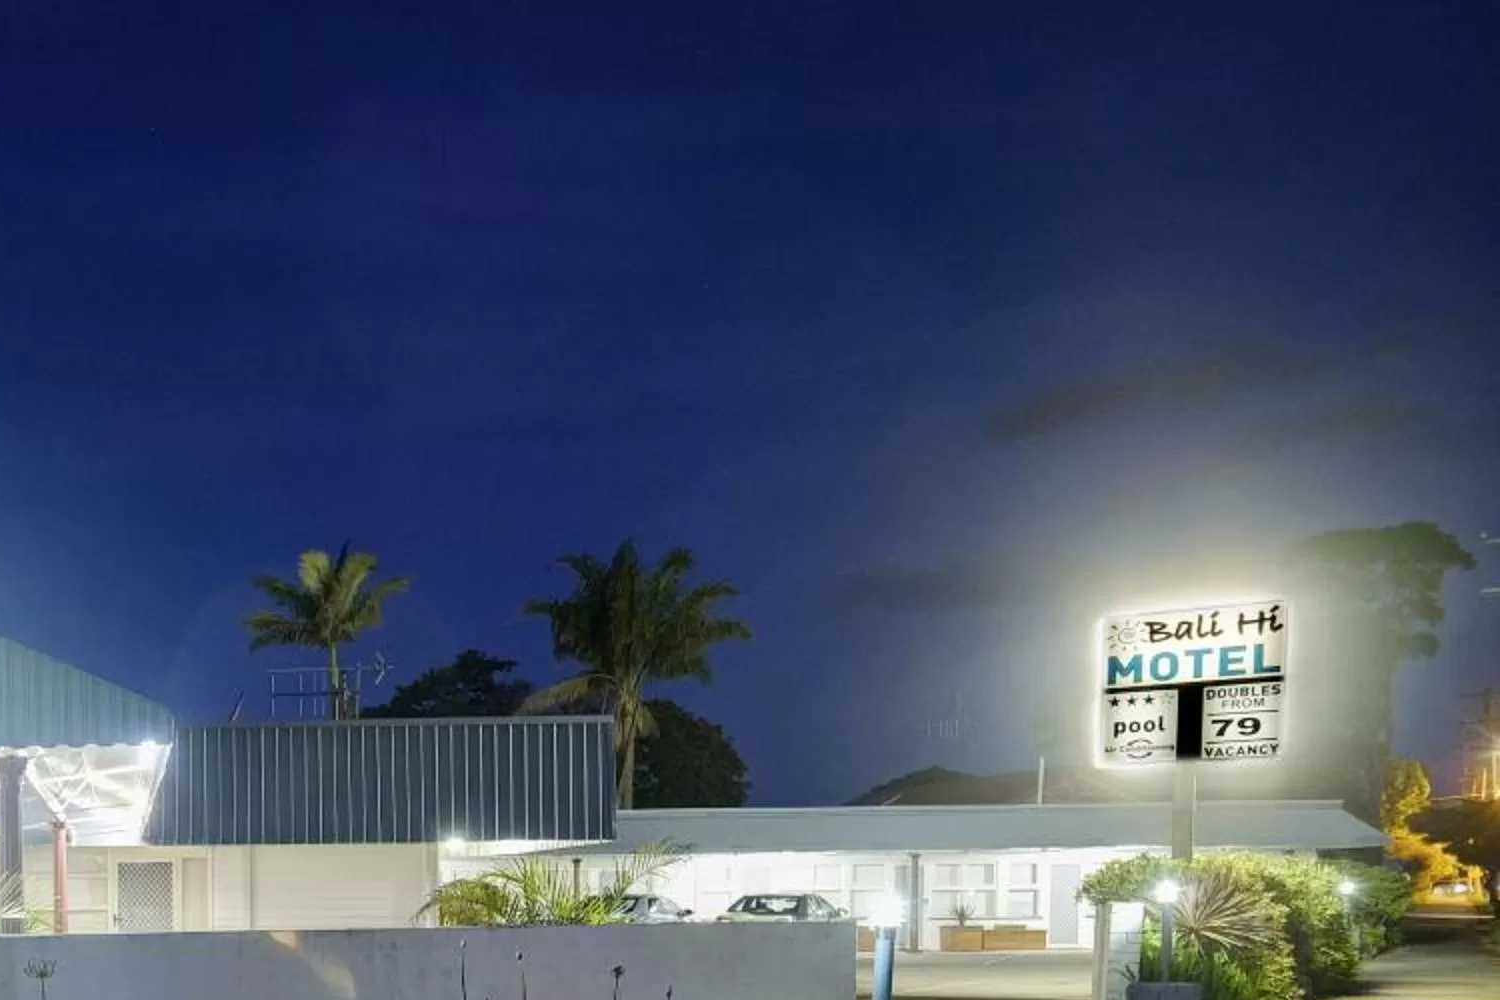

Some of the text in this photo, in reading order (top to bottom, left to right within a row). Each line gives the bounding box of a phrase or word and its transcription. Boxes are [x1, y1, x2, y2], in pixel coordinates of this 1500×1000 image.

[1145, 605, 1284, 643] Bali Hi
[1107, 643, 1281, 686] MOTEL
[1205, 684, 1281, 700] DOUBLES
[1221, 698, 1266, 709] FROM
[1113, 716, 1166, 737] pool
[1211, 717, 1261, 737] 79
[1203, 744, 1279, 758] VACANCY
